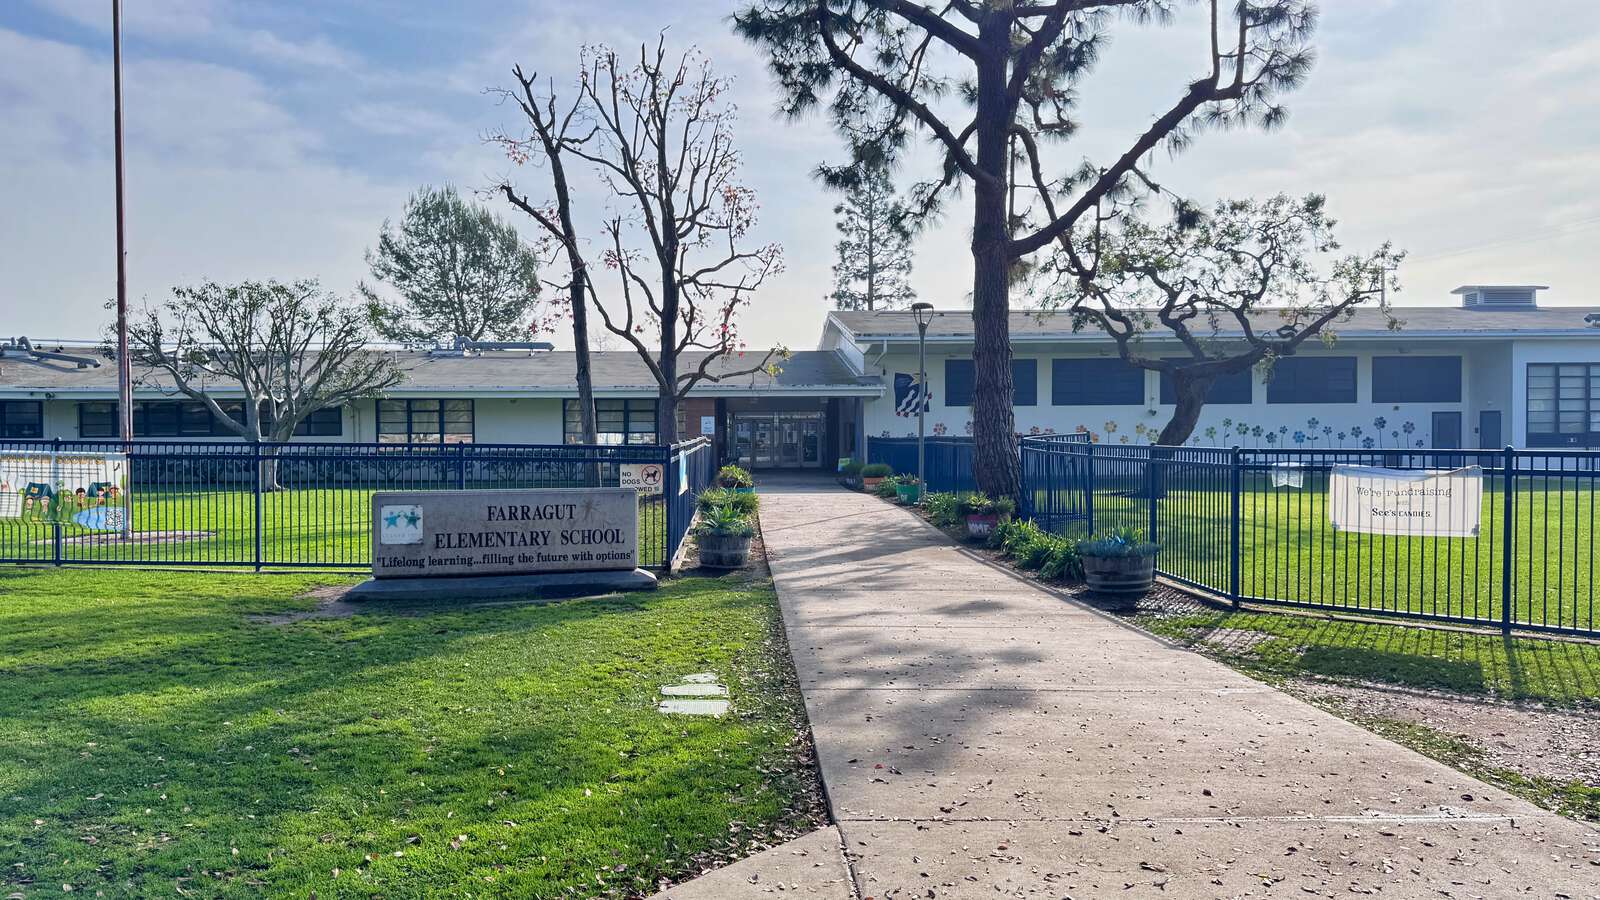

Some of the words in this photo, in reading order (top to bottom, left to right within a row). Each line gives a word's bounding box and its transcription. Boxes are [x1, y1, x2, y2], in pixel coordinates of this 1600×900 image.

[487, 504, 577, 521] FARRAGUT
[1371, 507, 1397, 517] See's
[434, 530, 551, 549] ELEMENTARY
[560, 528, 625, 545] SCHOOL
[376, 555, 425, 569] "Lifelong
[518, 552, 534, 563] the
[536, 552, 569, 563] future
[572, 551, 593, 561] with
[595, 549, 635, 562] options"
